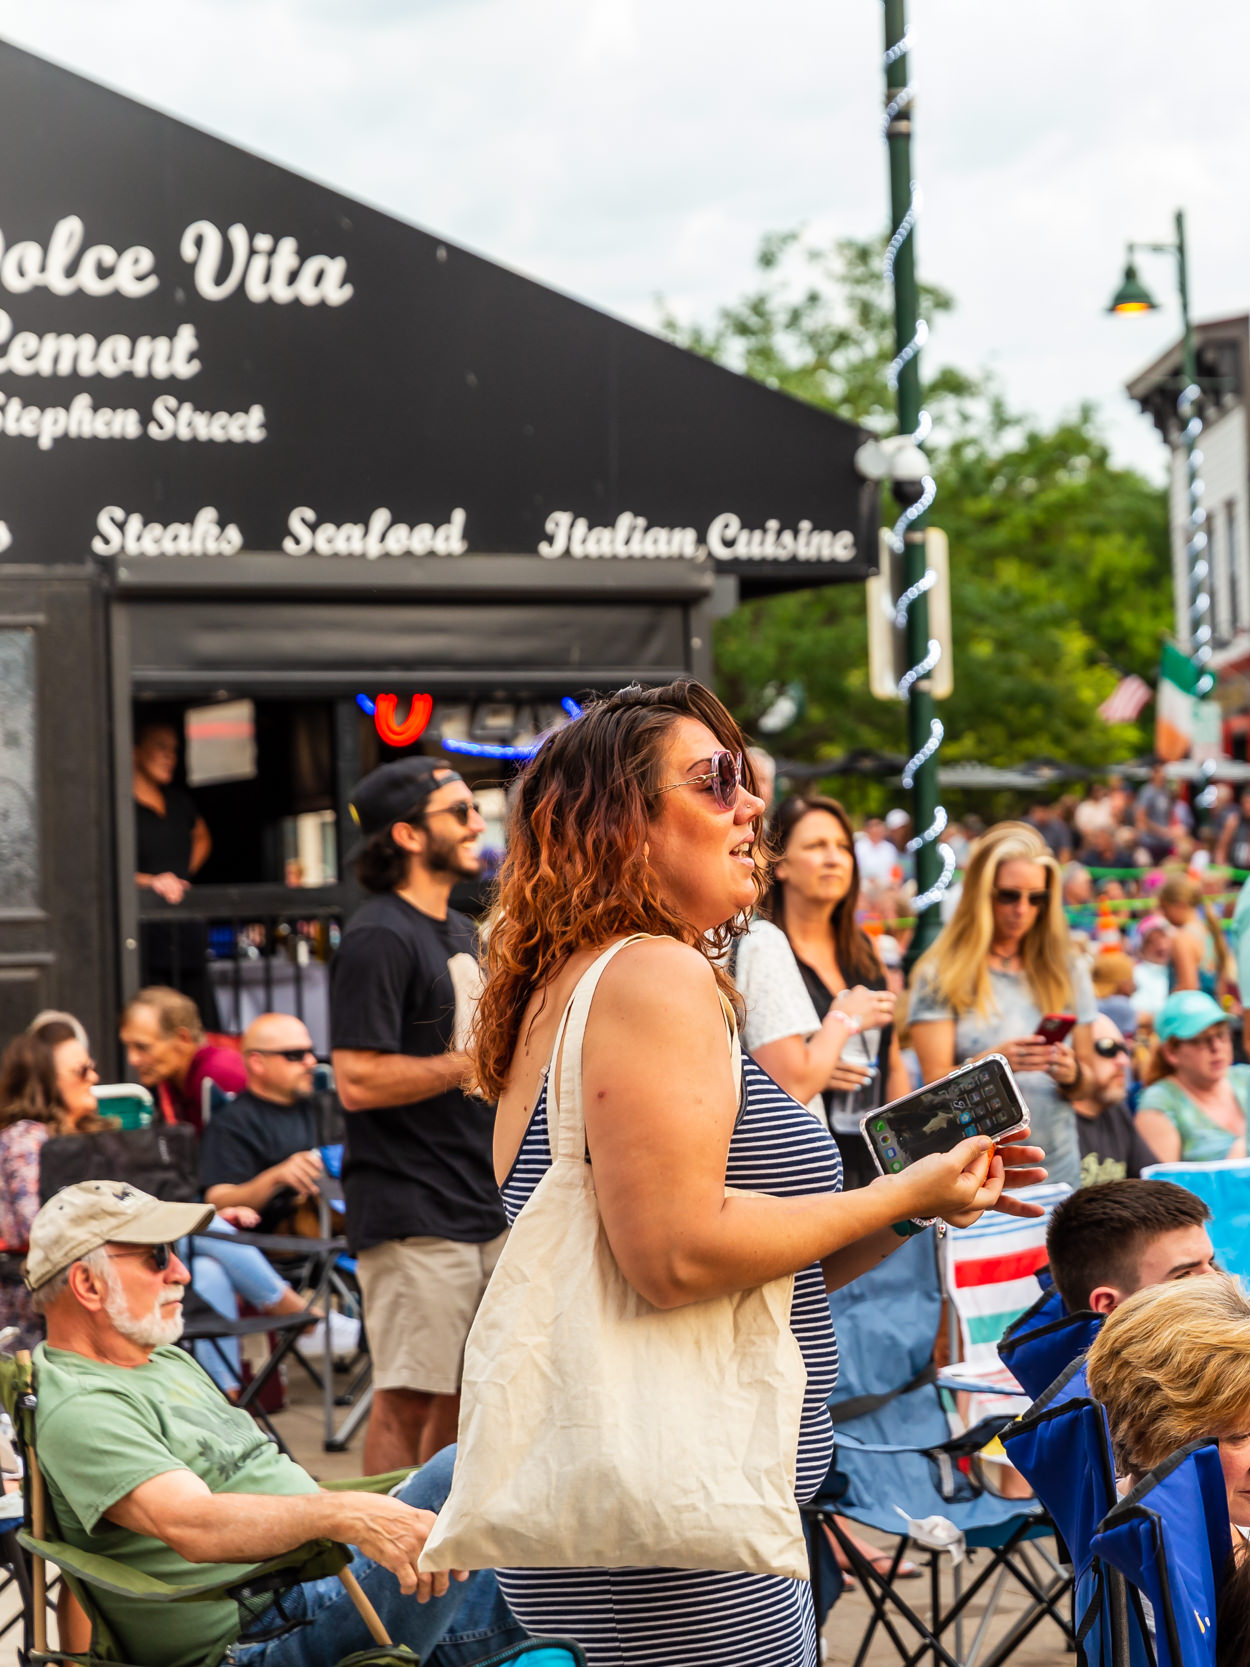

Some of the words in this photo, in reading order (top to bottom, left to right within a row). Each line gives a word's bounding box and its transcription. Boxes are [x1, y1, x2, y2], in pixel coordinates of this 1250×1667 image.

[0, 215, 159, 298] olce
[180, 219, 354, 306] Vita
[0, 391, 142, 450] tephen
[147, 395, 267, 443] Street
[91, 505, 243, 556] Steaks
[283, 506, 468, 560] Seafood
[538, 511, 699, 559] Italian
[707, 512, 856, 562] Cuisine
